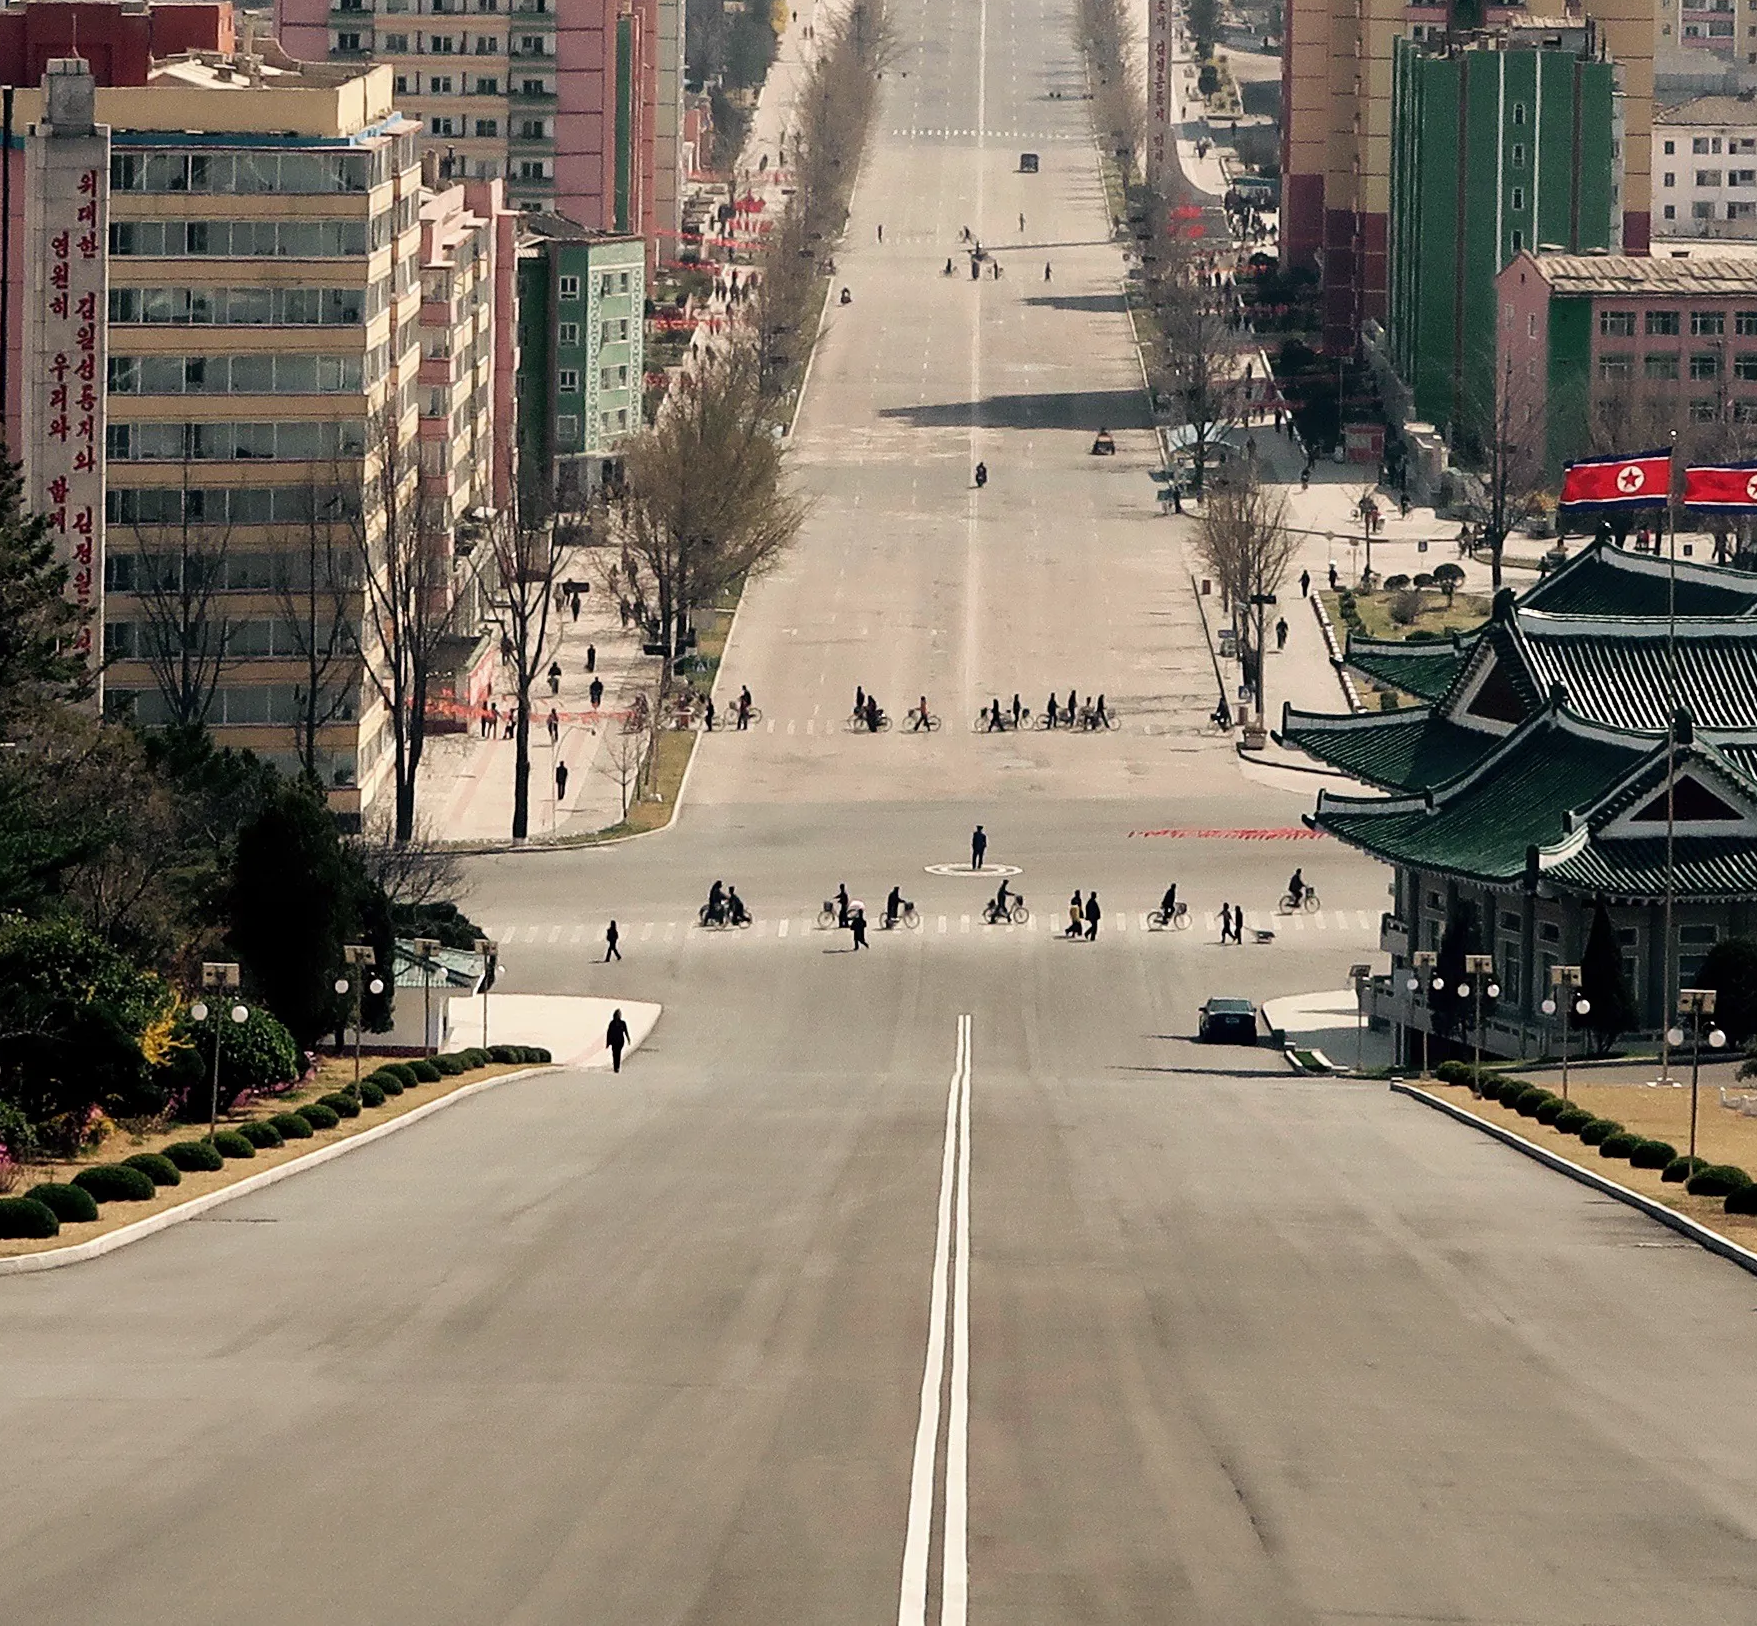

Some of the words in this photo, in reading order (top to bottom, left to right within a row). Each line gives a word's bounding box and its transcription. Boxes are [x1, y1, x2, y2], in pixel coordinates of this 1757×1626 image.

[77, 169, 98, 259] 위대한
[49, 230, 69, 321] 영원히
[48, 352, 71, 443] 우리와
[73, 292, 98, 474] 김일성동지와
